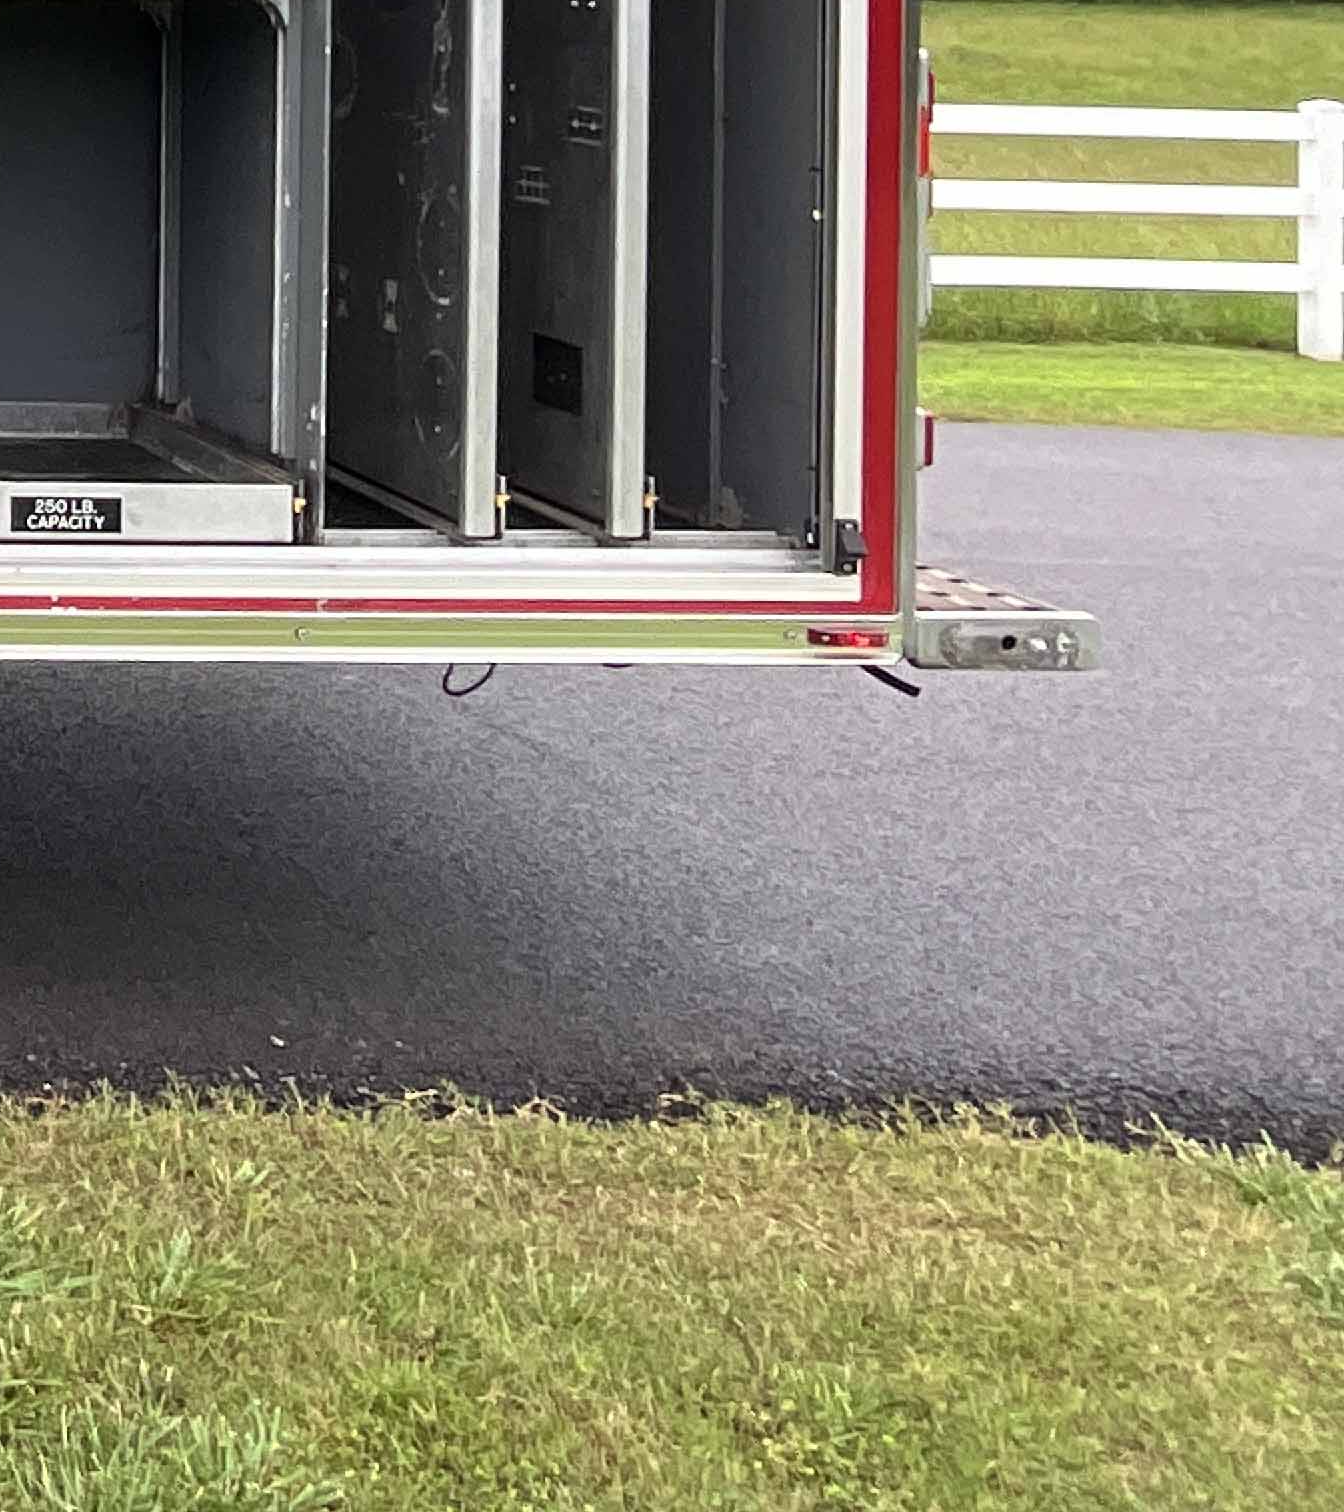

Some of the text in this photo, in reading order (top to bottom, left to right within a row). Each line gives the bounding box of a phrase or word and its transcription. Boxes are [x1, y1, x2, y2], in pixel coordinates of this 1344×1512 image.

[34, 498, 98, 514] 250 LB.
[26, 514, 106, 530] CAPACITY
